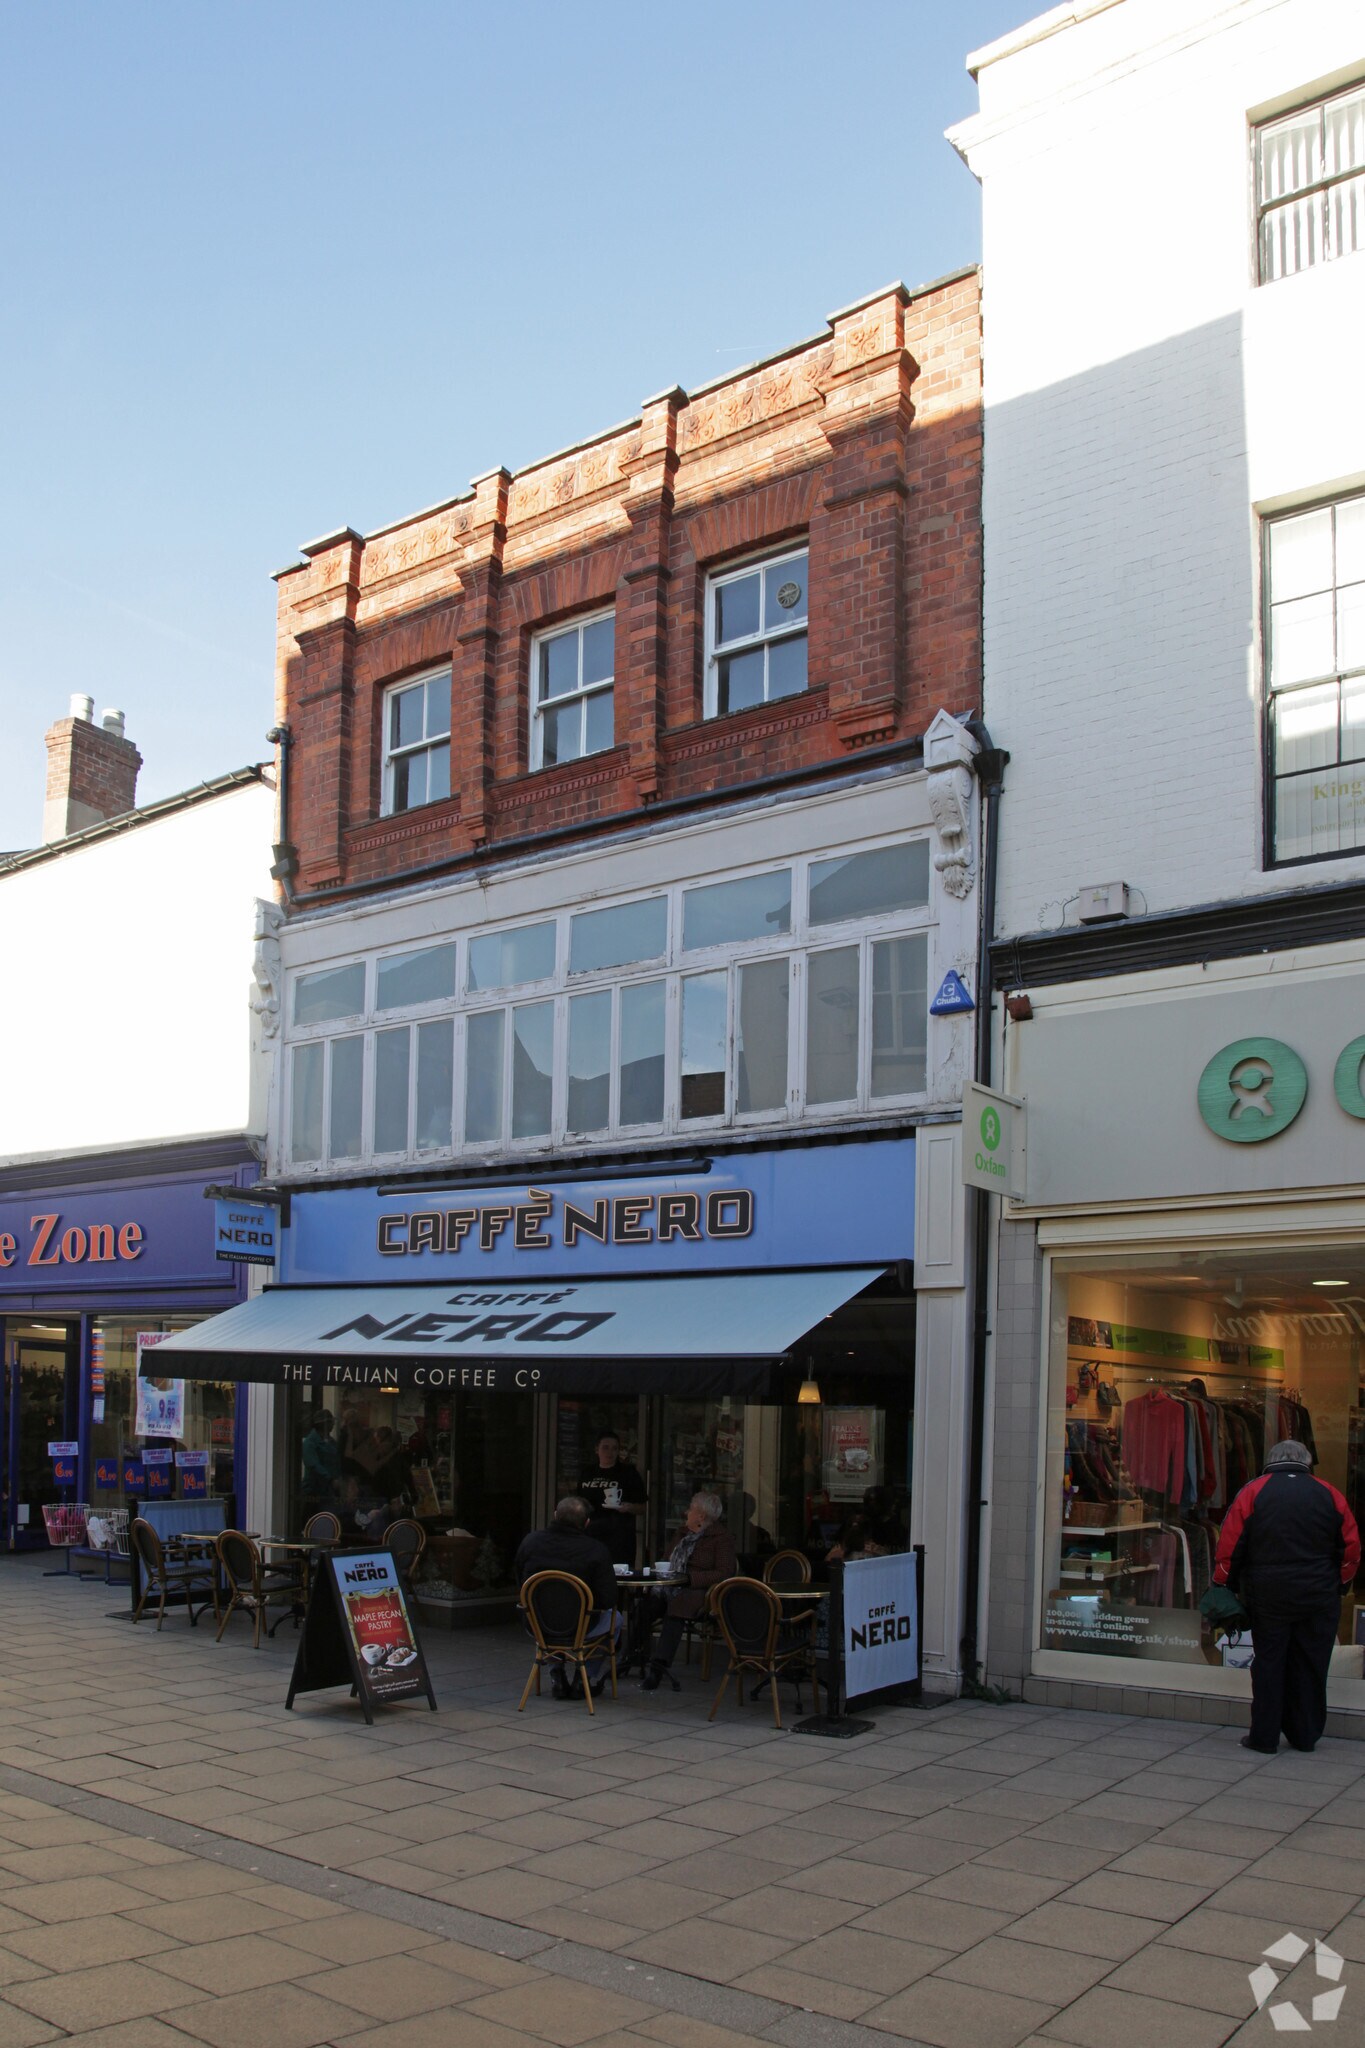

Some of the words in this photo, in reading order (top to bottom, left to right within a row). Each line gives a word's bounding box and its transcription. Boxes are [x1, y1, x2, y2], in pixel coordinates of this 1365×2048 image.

[936, 996, 960, 1005] Chubb
[975, 1153, 1006, 1177] Oxfam
[377, 1187, 552, 1254] CAFFÈ
[563, 1189, 753, 1246] NERO
[27, 1214, 142, 1265] Zone
[219, 1227, 273, 1245] NERO
[446, 1288, 578, 1305] CAFFÈ
[318, 1311, 617, 1342] NERO
[283, 1364, 312, 1381] THE
[327, 1365, 398, 1383] ITALIAN
[414, 1368, 496, 1387] COFFEE
[159, 1398, 176, 1419] 9.99
[344, 1567, 388, 1583] NERO
[354, 1612, 377, 1623] MAPLE
[377, 1609, 402, 1620] PECAN
[868, 1601, 895, 1618] CAFFÈ
[368, 1620, 392, 1631] PASTRY
[1103, 1622, 1134, 1631] online
[1124, 1615, 1150, 1624] gems
[851, 1616, 911, 1651] NERO
[1045, 1626, 1199, 1648] www.oxfam.org.uk/shop
